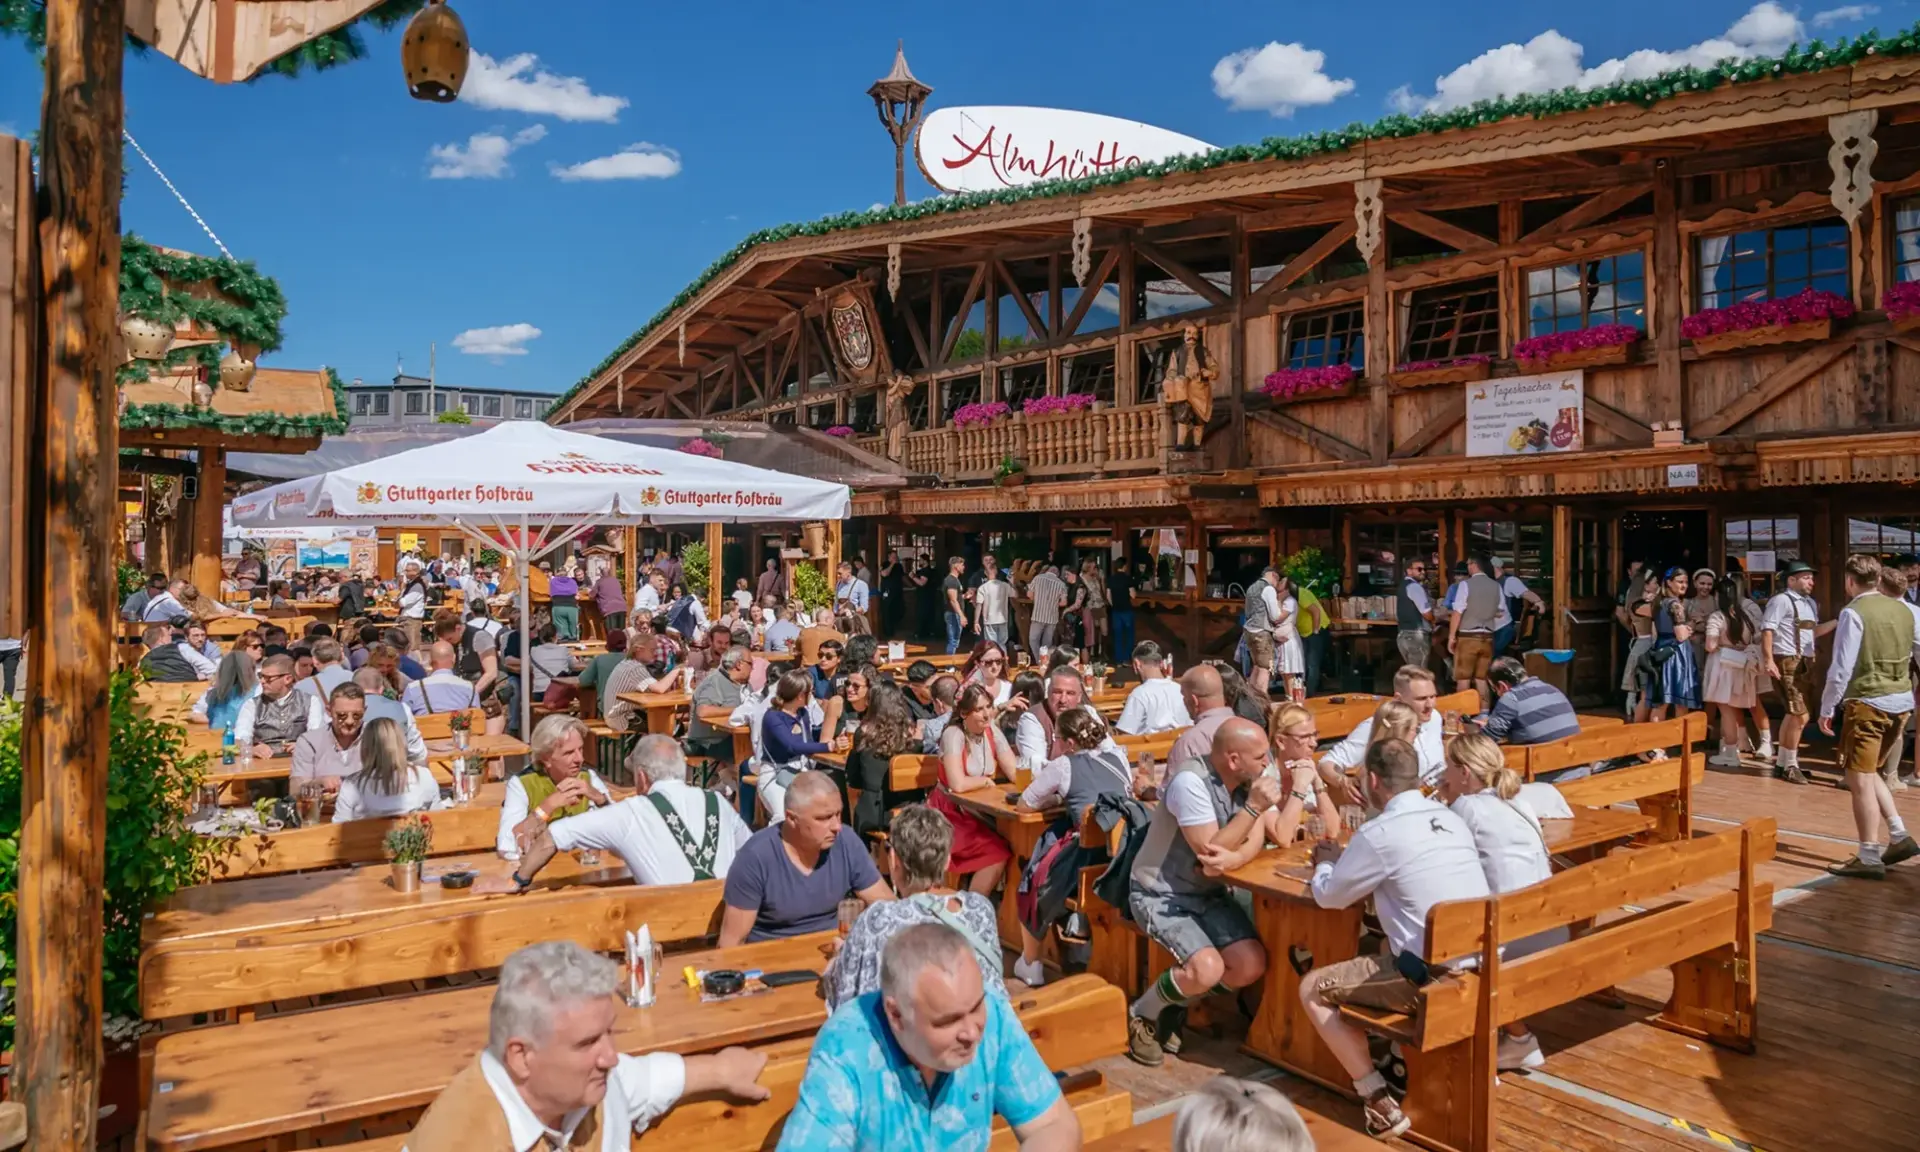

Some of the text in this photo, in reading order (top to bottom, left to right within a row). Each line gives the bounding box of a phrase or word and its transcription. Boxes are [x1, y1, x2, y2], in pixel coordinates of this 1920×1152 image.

[1669, 470, 1696, 479] NA 40
[387, 484, 534, 505] Stuttgarter Hofbräu
[664, 489, 782, 507] Stuttgarter Hofbräu
